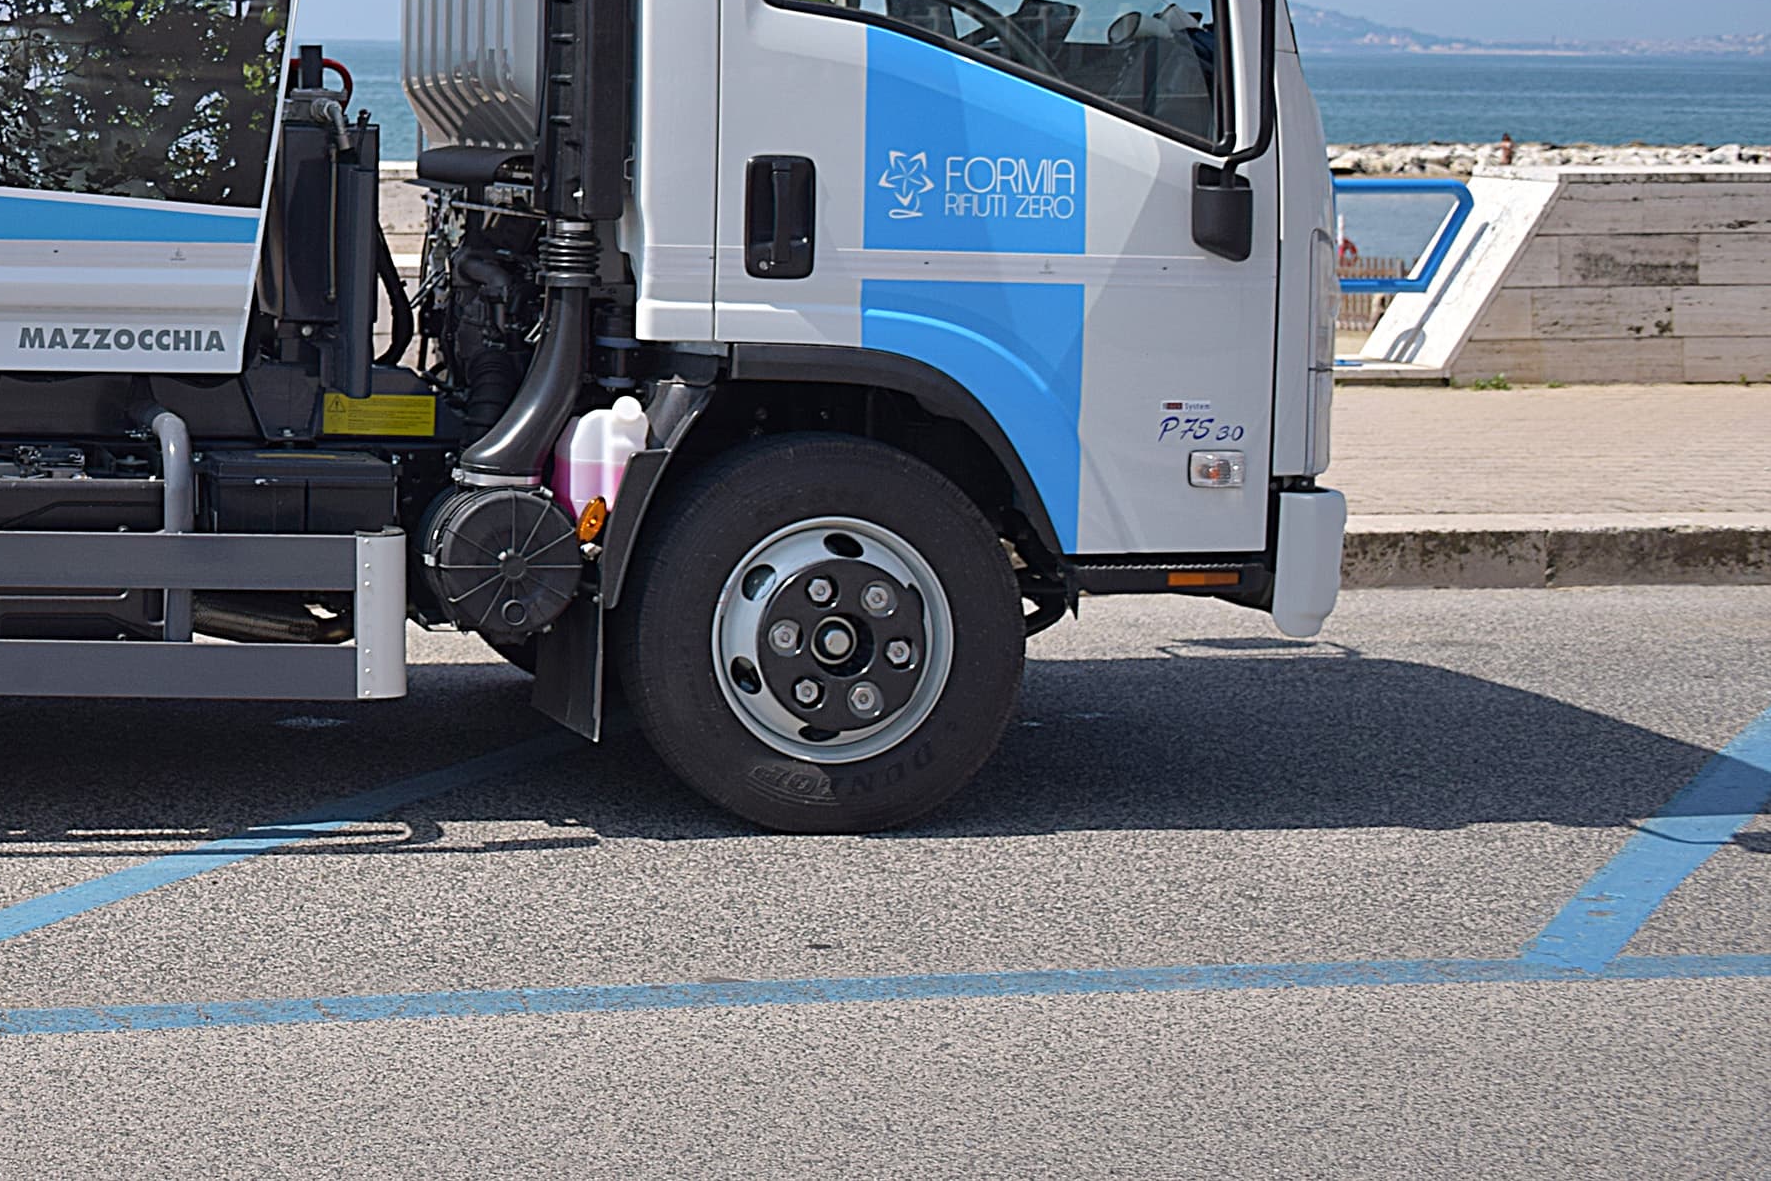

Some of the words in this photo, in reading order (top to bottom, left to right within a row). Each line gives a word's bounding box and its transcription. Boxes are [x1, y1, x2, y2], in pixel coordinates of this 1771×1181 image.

[944, 156, 1076, 195] FORMIA
[943, 193, 1008, 218] RIFIUTI
[1014, 194, 1076, 220] ZERO
[18, 326, 226, 352] MAZZOCCHIA
